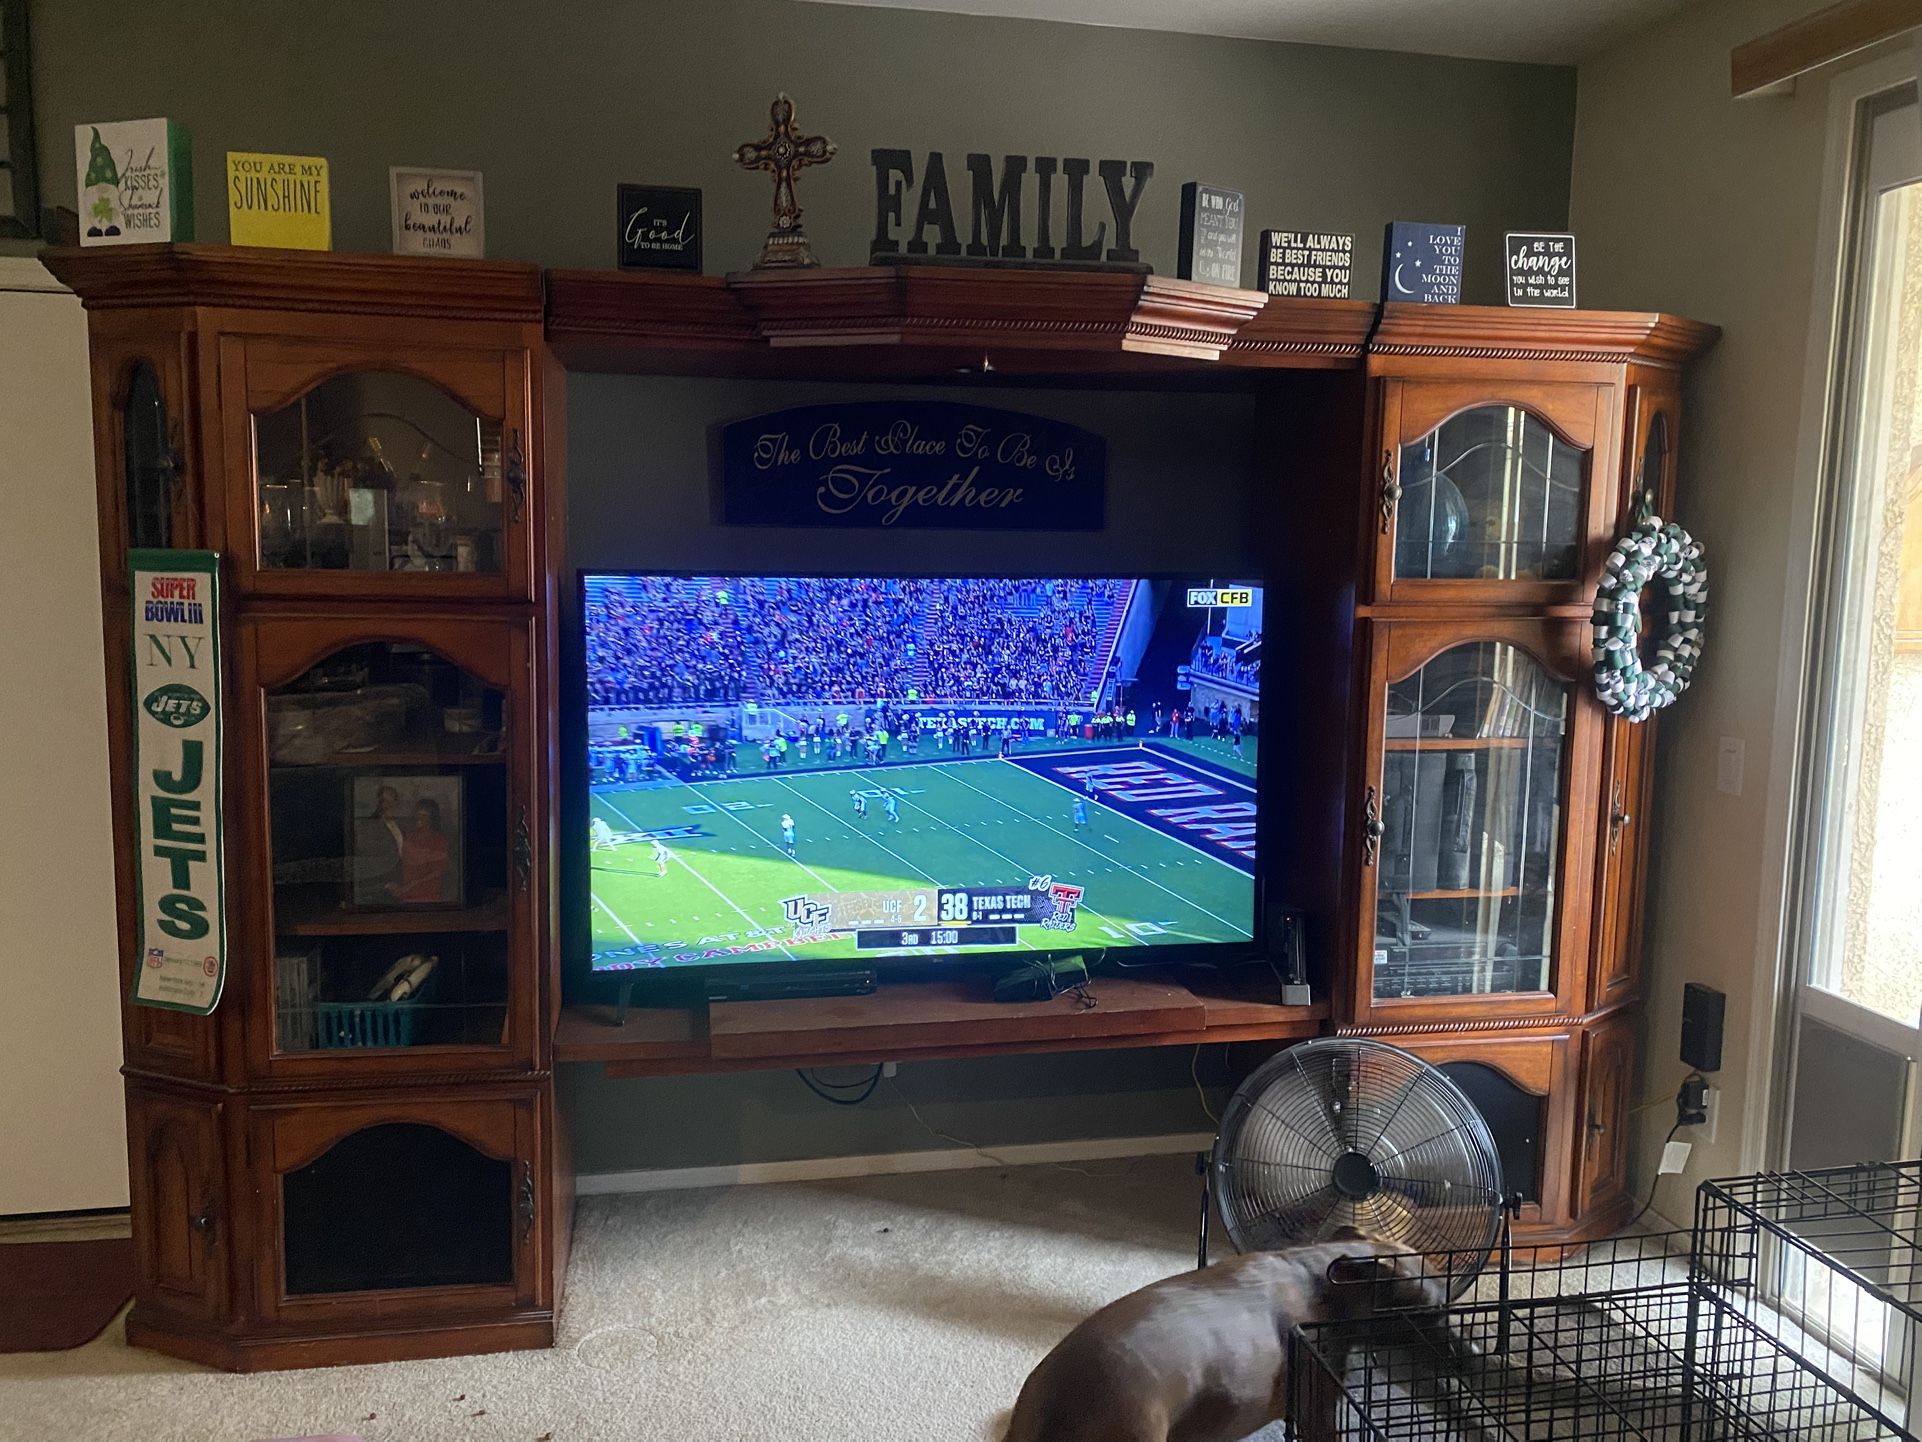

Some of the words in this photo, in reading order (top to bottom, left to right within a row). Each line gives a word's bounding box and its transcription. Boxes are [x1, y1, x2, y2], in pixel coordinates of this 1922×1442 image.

[232, 160, 262, 173] YOU
[268, 163, 296, 175] ARE
[301, 165, 322, 176] MY
[124, 173, 160, 191] KISSES
[409, 179, 467, 200] welcome
[233, 176, 321, 214] SUNSHINE
[871, 149, 1154, 262] FAMILY
[124, 211, 161, 229] WISHES
[404, 211, 472, 235] beautiful
[625, 207, 695, 249] Good
[1457, 226, 1462, 236] I
[662, 243, 683, 251] HOME
[1271, 232, 1303, 248] WE'LL
[1306, 234, 1352, 251] ALWAYS
[1429, 235, 1461, 246] LOVE
[1533, 242, 1545, 252] BE
[1548, 242, 1564, 252] THE
[1270, 248, 1283, 262] BE
[1285, 249, 1309, 264] BEST
[1311, 251, 1351, 266] FRIENDS
[1434, 245, 1460, 255] YOU
[1442, 256, 1460, 265] TO
[1511, 245, 1571, 275] change
[1269, 265, 1323, 282] BECAUSE
[1325, 268, 1349, 283] YOU
[1421, 274, 1457, 284] MOON
[1433, 265, 1459, 275] THE
[1268, 281, 1298, 296] KNOW
[1300, 282, 1319, 296] TOO
[1321, 284, 1349, 298] MUCH
[1431, 284, 1457, 294] AND
[1424, 293, 1456, 304] BACK
[753, 432, 801, 469] The
[809, 422, 869, 460] Best
[874, 420, 945, 455] Place
[956, 424, 991, 459] To
[997, 432, 1037, 469] Be
[1046, 447, 1076, 482] Is
[816, 466, 1024, 526] Together
[151, 576, 196, 600] SUPER
[1190, 591, 1216, 604] FOX
[1220, 592, 1249, 604] CFB
[145, 601, 187, 623] BOWL
[188, 602, 203, 624] III
[143, 634, 205, 669] NY
[151, 695, 203, 714] JETS
[150, 740, 210, 941] JETS
[1030, 876, 1051, 891] #6
[780, 896, 830, 927] UCF
[882, 899, 902, 913] UCF
[913, 894, 928, 922] 2
[941, 893, 968, 920] 38
[972, 895, 1004, 910] TEXAS
[1006, 894, 1031, 909] TECH
[1040, 917, 1076, 932] RAIDERS
[1053, 910, 1069, 923] RED
[902, 931, 919, 945] 3RD
[930, 930, 959, 945] 15:00
